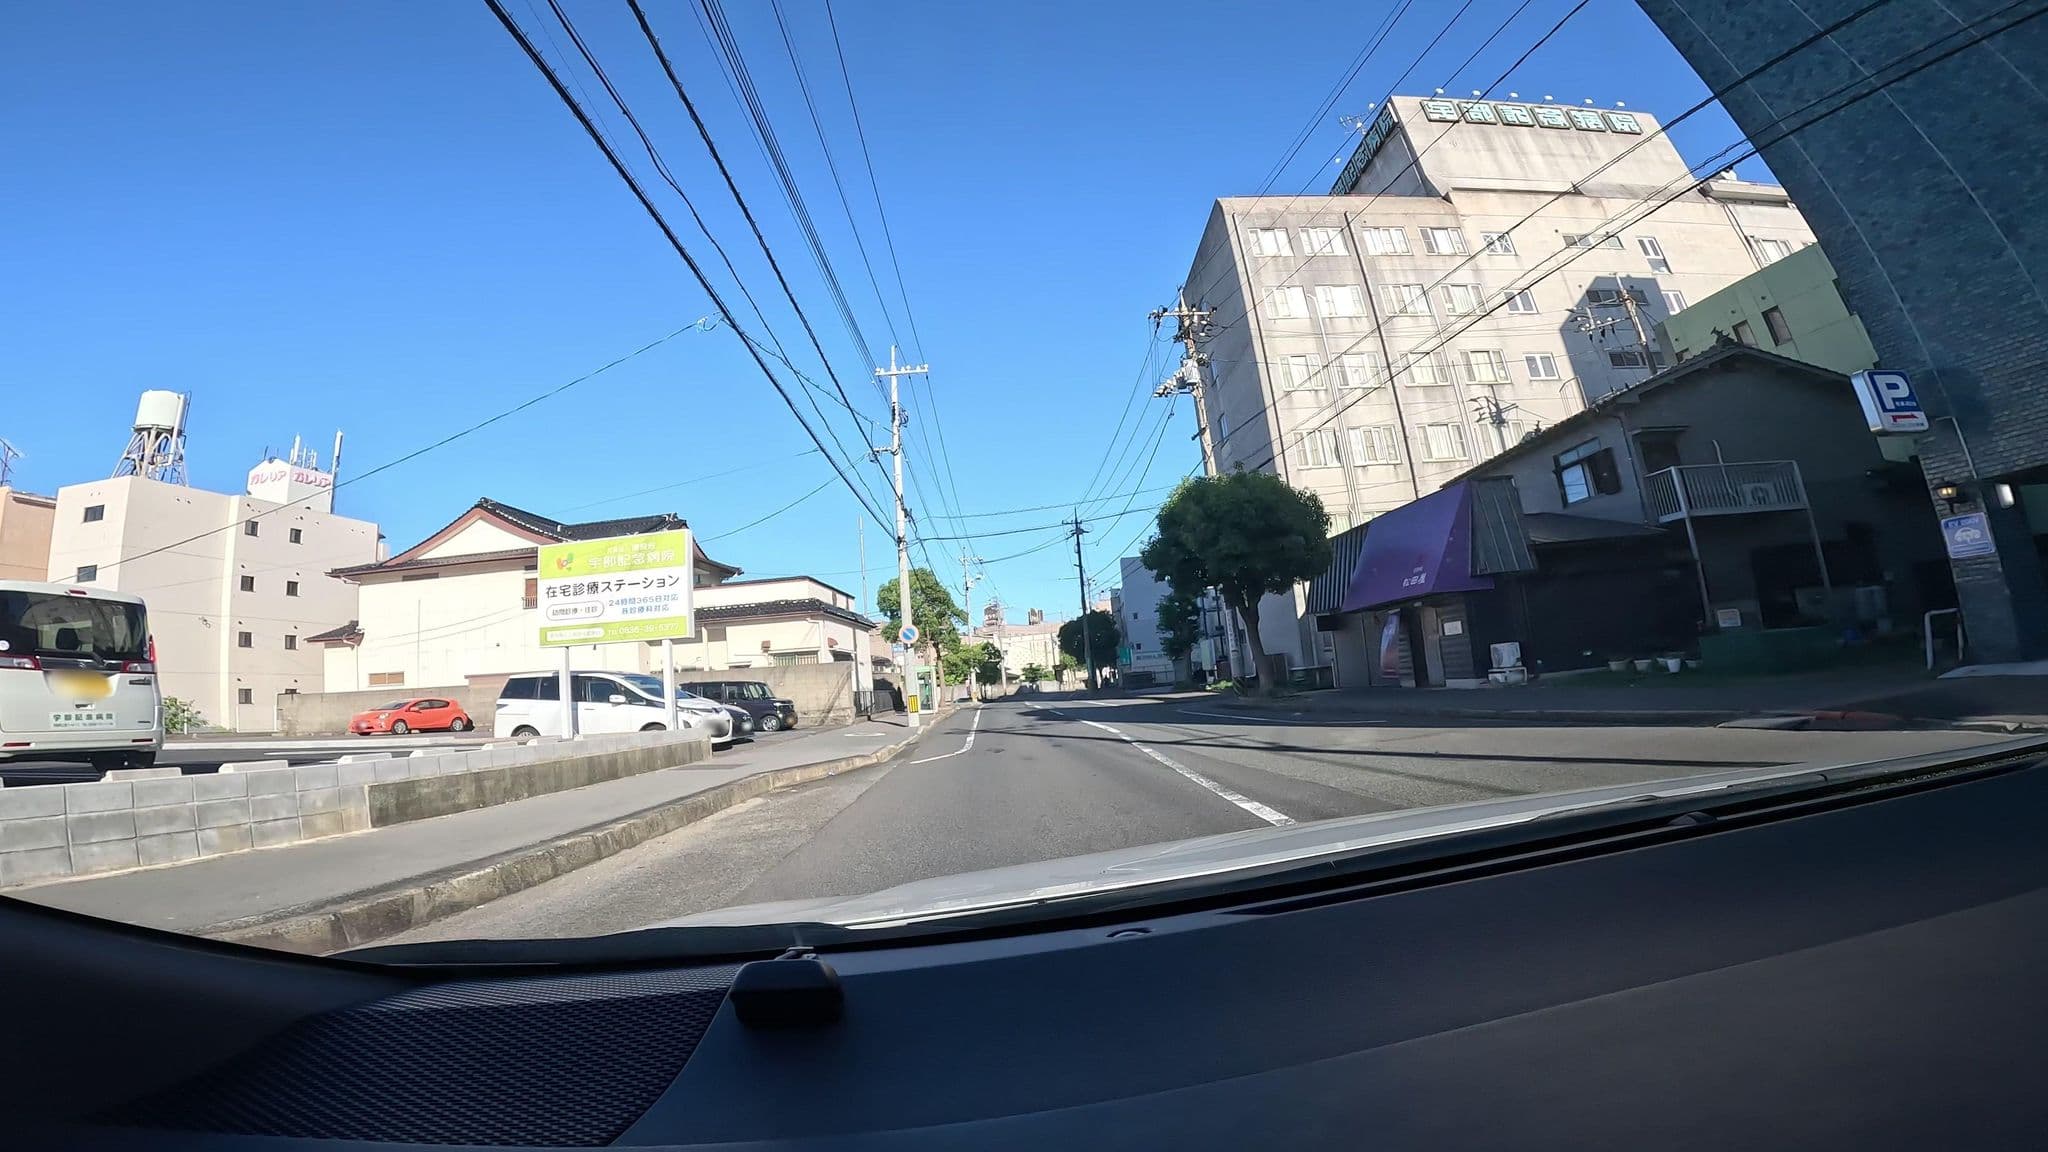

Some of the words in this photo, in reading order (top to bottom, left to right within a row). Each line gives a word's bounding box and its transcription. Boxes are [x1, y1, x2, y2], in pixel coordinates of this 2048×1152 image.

[1424, 100, 1641, 133] 宇部記念病院
[1873, 374, 1910, 410] P
[588, 550, 675, 568] 宇部記念病院
[545, 575, 680, 599] 在宅診療ステーション
